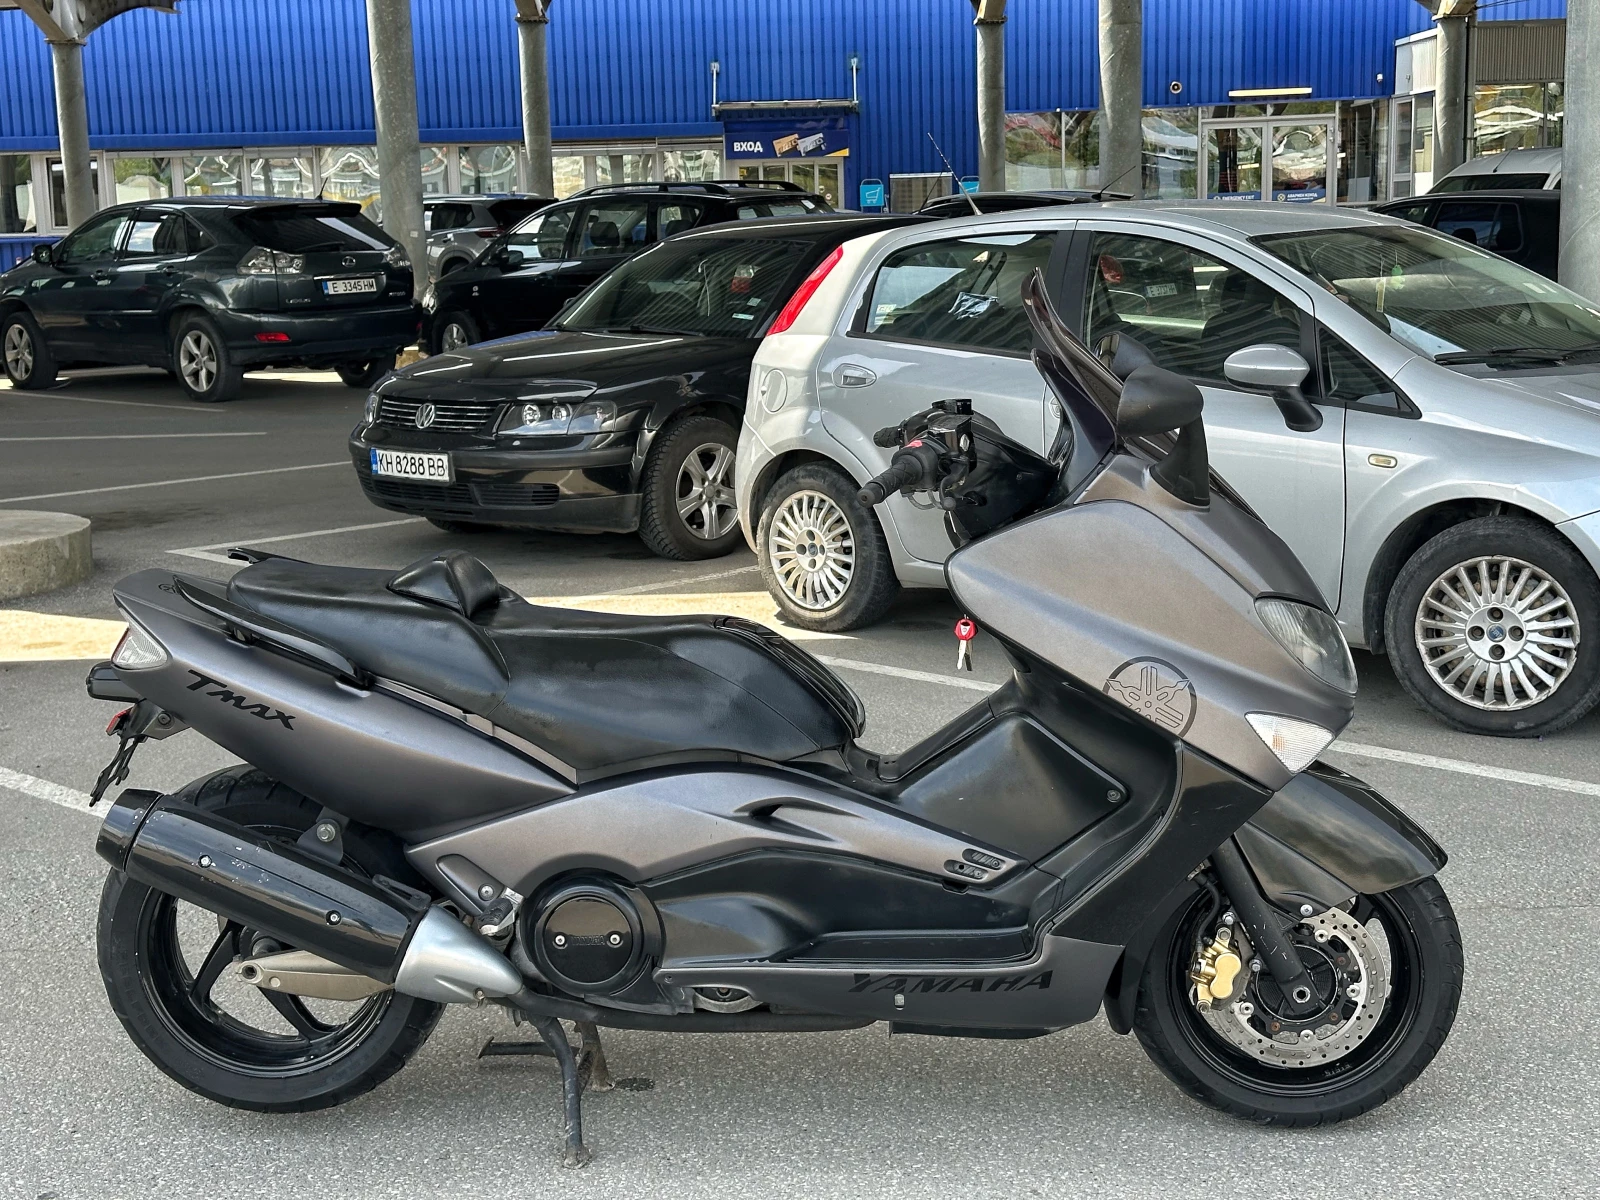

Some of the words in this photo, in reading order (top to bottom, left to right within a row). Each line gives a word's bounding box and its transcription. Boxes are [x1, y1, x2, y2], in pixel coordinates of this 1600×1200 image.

[733, 141, 763, 153] ВХОД
[332, 282, 339, 293] E
[342, 281, 363, 292] 3345
[363, 280, 375, 291] HM
[378, 453, 394, 473] KH
[395, 455, 426, 475] 8288
[427, 457, 446, 477] BB
[848, 970, 1054, 993] YAMAHA
